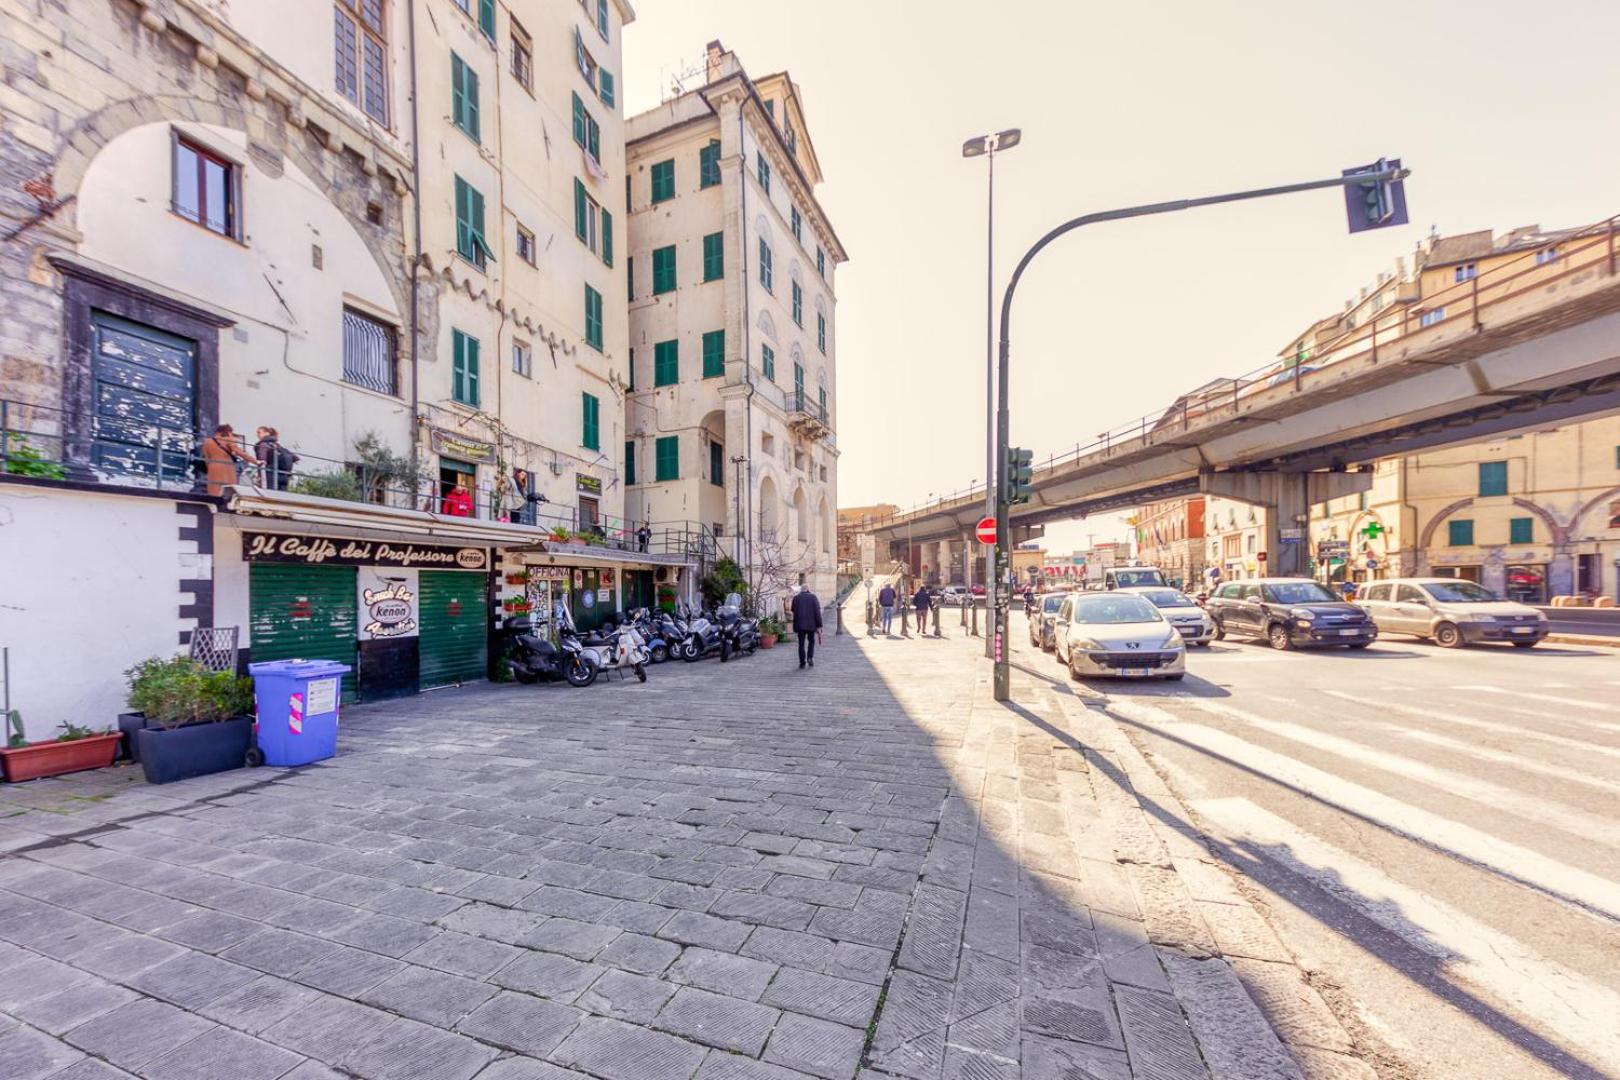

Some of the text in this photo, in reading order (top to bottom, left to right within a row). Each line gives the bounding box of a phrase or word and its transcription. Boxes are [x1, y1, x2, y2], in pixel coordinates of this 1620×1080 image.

[249, 535, 455, 566] Il Caffè del Professore
[527, 566, 570, 577] OFFICINA
[376, 606, 406, 617] kenon
